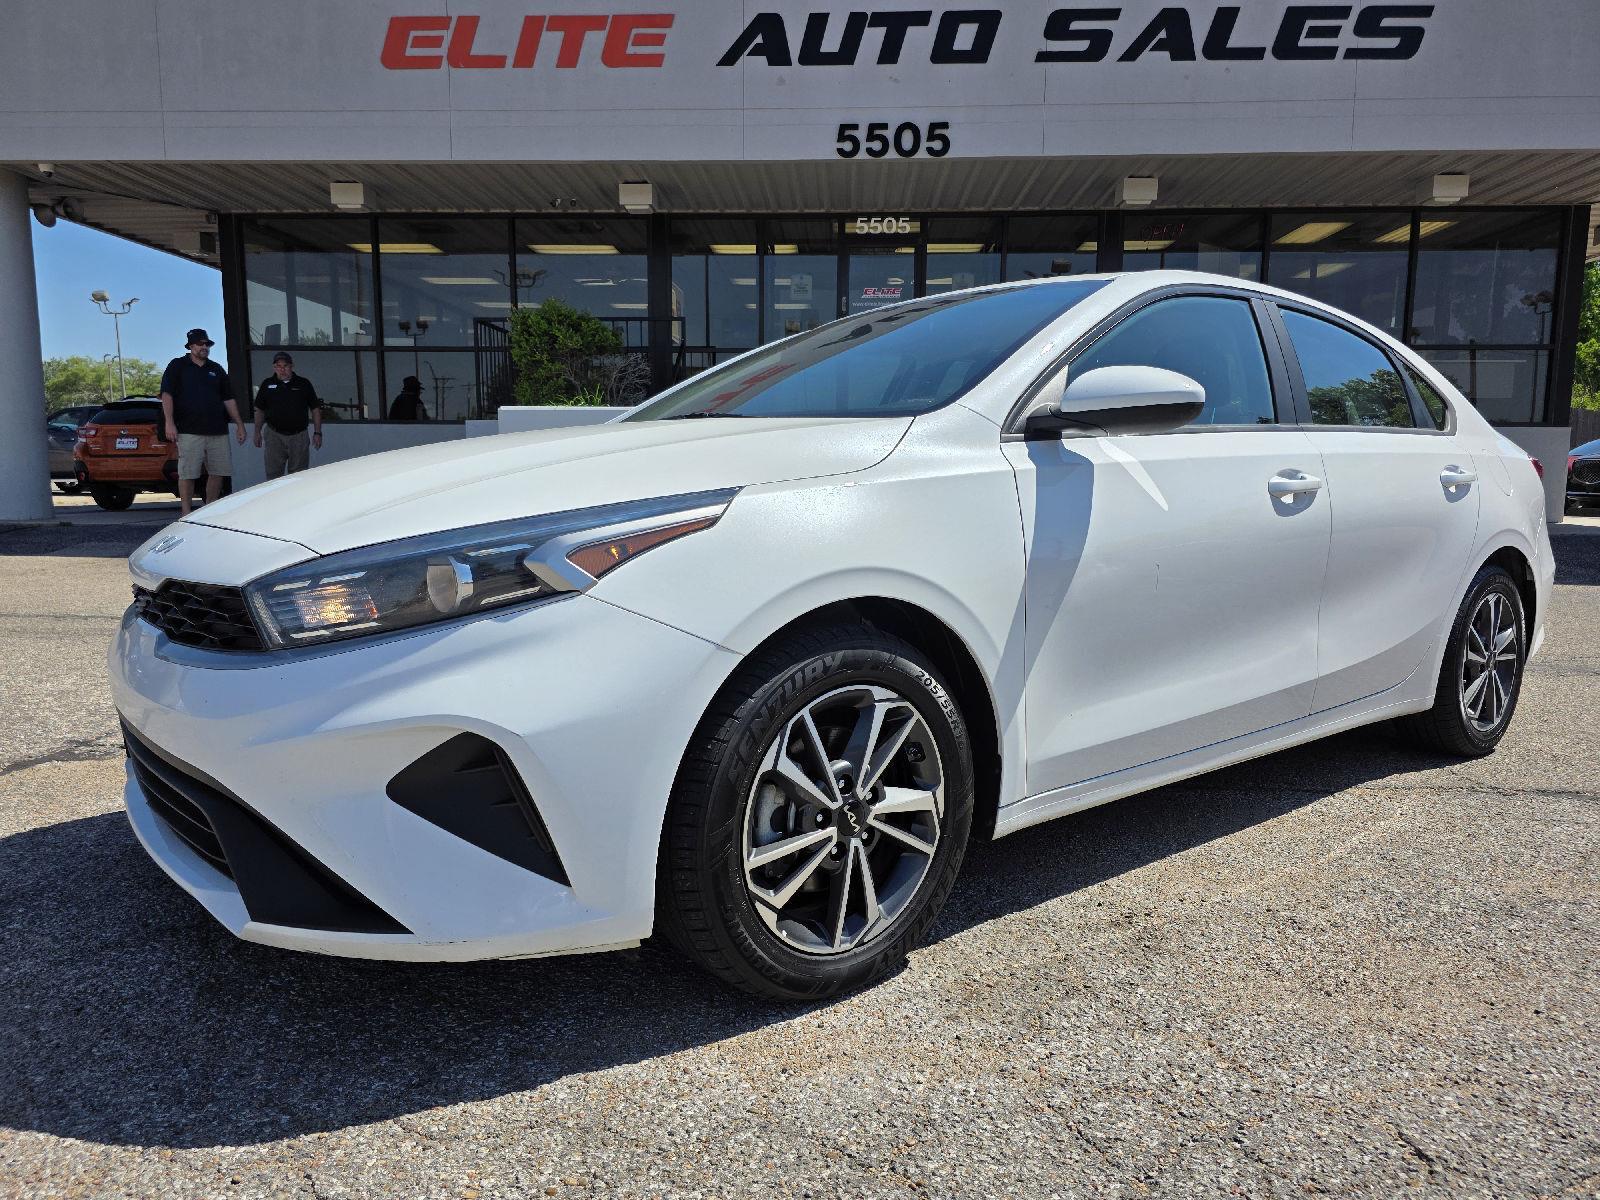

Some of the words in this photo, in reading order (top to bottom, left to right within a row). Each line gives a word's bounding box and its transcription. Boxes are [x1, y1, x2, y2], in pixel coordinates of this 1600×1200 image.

[380, 14, 675, 70] ELITE
[715, 10, 1003, 66] AUTO
[1034, 5, 1435, 63] SALES
[836, 121, 950, 158] 5505
[856, 217, 911, 234] 5505
[863, 287, 902, 296] ELITE
